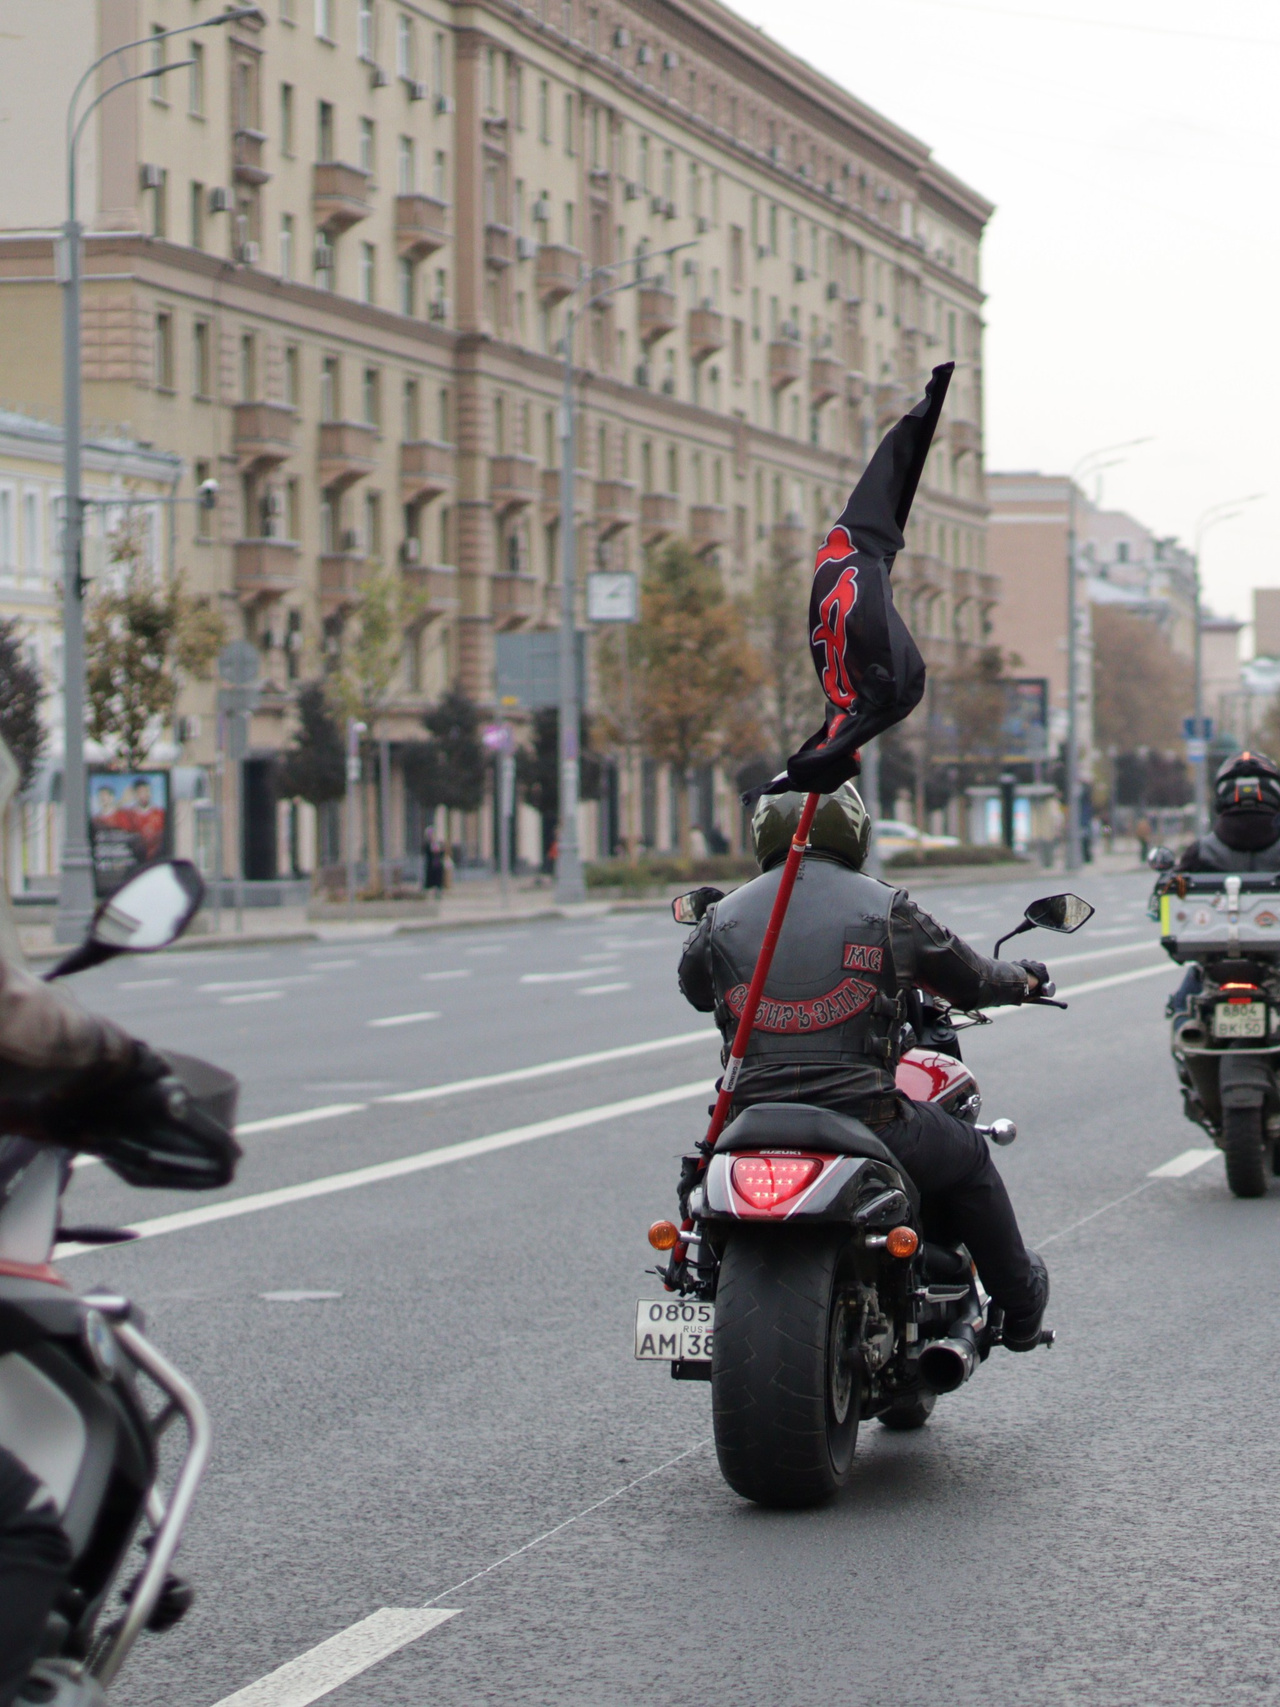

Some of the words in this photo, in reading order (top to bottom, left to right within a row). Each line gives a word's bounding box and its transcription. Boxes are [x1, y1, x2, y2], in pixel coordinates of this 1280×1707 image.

[649, 1303, 710, 1322] 0805
[639, 1333, 676, 1355] AM
[688, 1334, 714, 1356] 38
